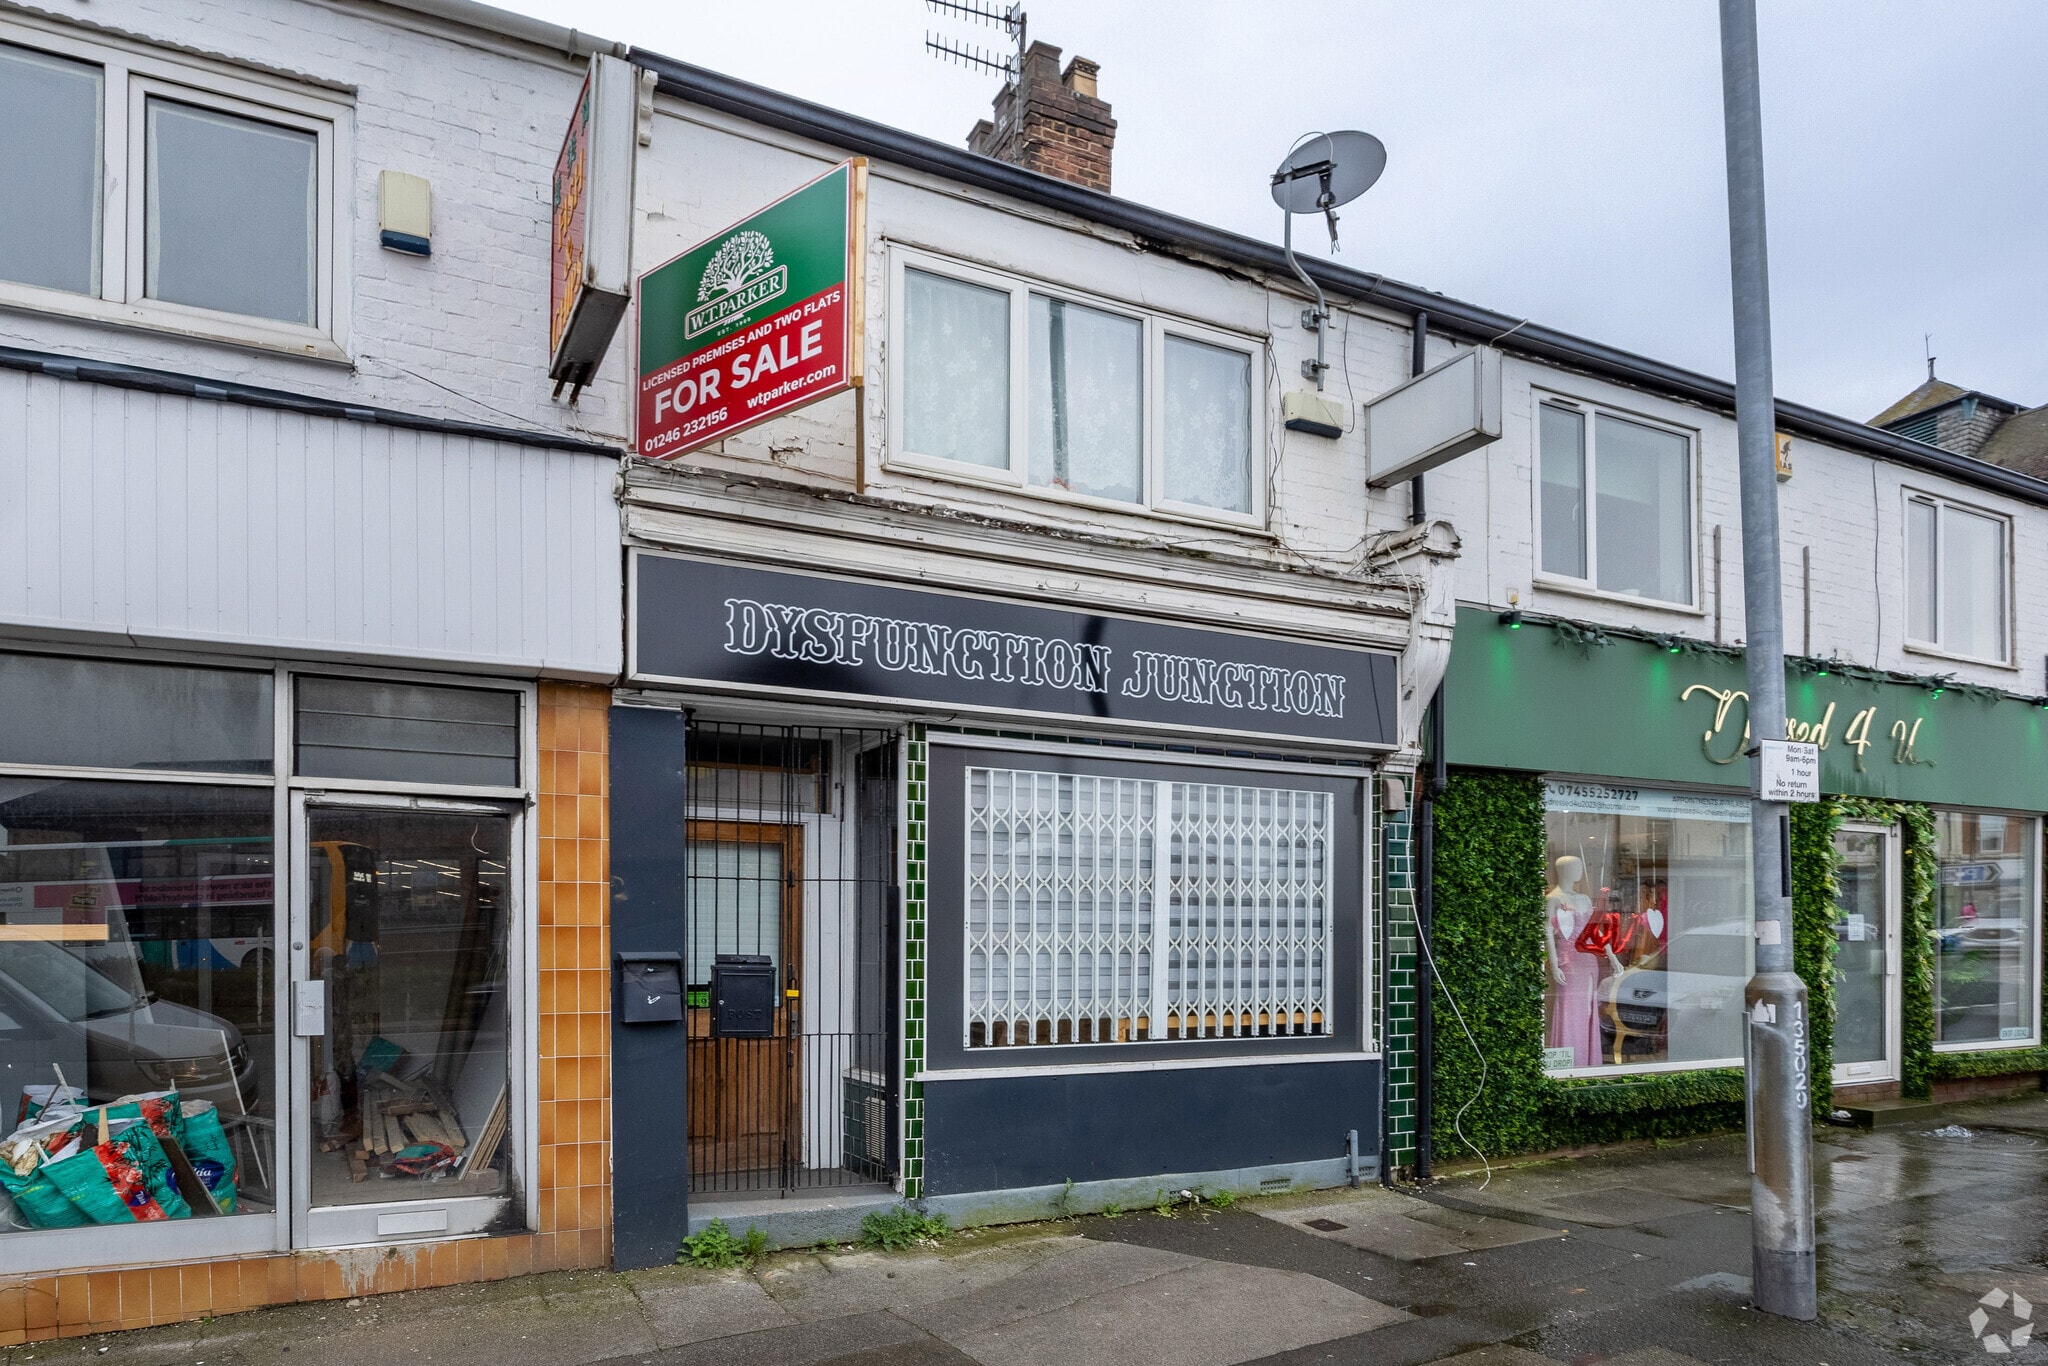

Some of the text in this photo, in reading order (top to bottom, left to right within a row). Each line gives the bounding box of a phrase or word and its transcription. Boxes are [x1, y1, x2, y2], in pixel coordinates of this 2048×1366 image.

[642, 290, 840, 391] LICENSED PREMISES AND TWO FLATS
[655, 319, 822, 424] FOR SALE
[645, 364, 836, 452] 01246 232156 wtparker.com
[724, 597, 1346, 718] DYSFUNCTION JUNCTION
[1796, 768, 1812, 777] hour
[1845, 706, 1875, 773] 4
[1558, 784, 1639, 801] 07455252727
[1768, 789, 1789, 797] within
[1796, 790, 1816, 799] hours
[1776, 779, 1808, 789] No return
[727, 1008, 762, 1020] POST
[1793, 1001, 1808, 1110] 135029
